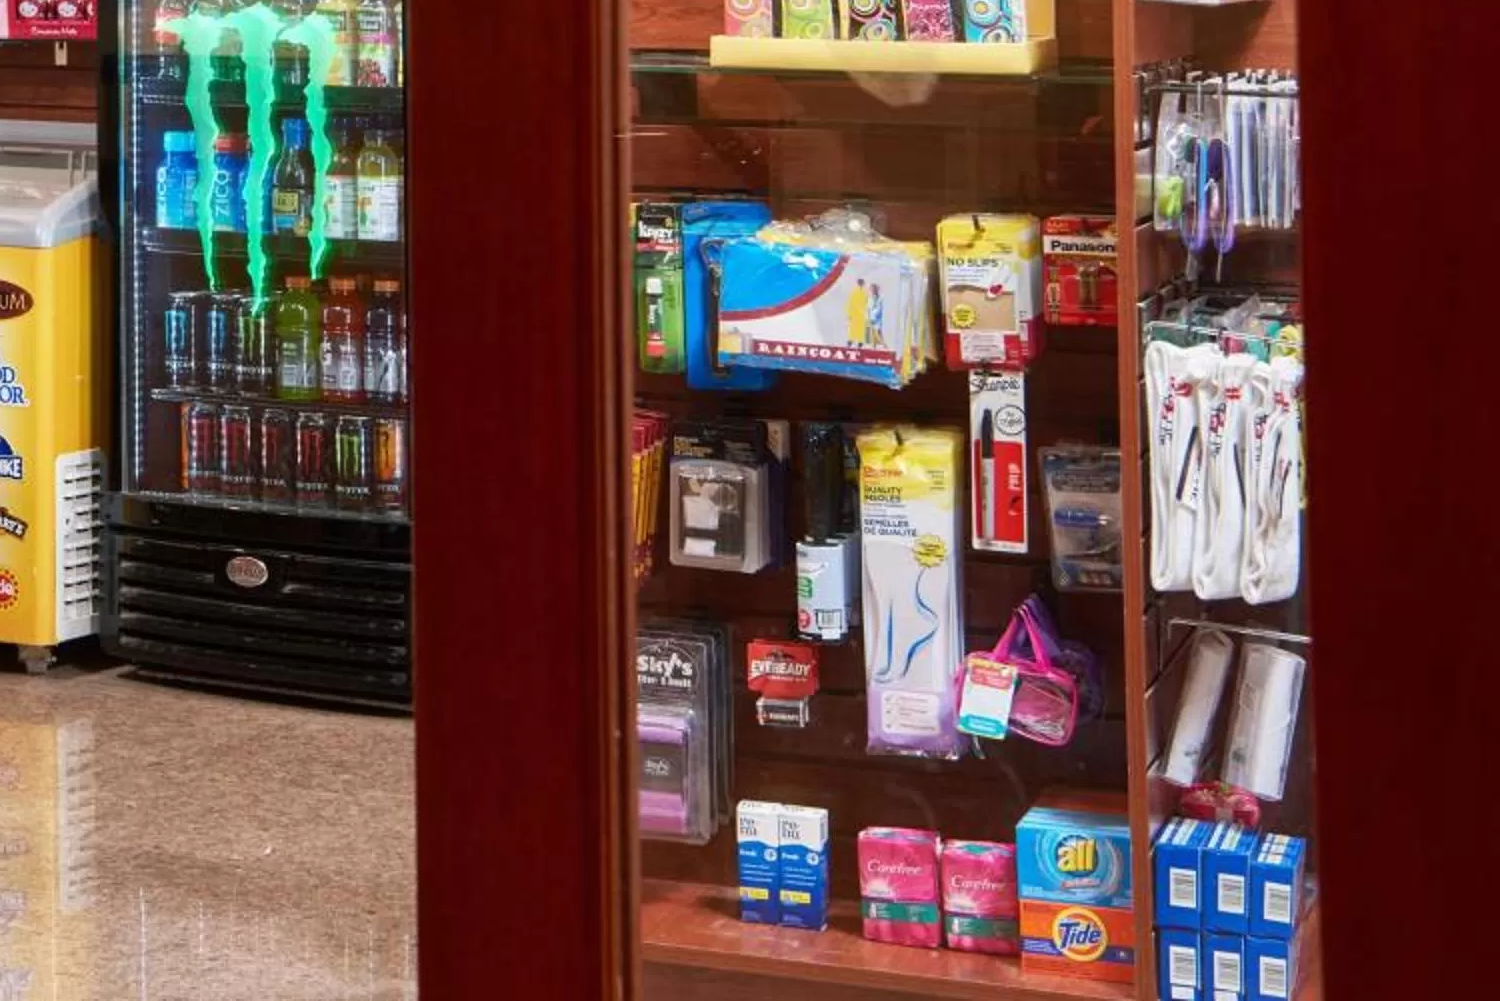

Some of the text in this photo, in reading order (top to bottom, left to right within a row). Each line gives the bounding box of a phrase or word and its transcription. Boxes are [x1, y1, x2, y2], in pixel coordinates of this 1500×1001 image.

[215, 170, 229, 216] ZICO
[1051, 239, 1116, 253] Panason
[948, 257, 999, 269] NO SLIPS
[758, 342, 861, 362] RAINCOAT
[971, 374, 1022, 393] Sharpie
[637, 652, 693, 677] Sky's
[751, 659, 811, 678] EVEREADY
[1056, 837, 1095, 872] all
[868, 859, 923, 875] Carefree
[951, 875, 1006, 891] Carefree
[1059, 921, 1102, 949] Tide
